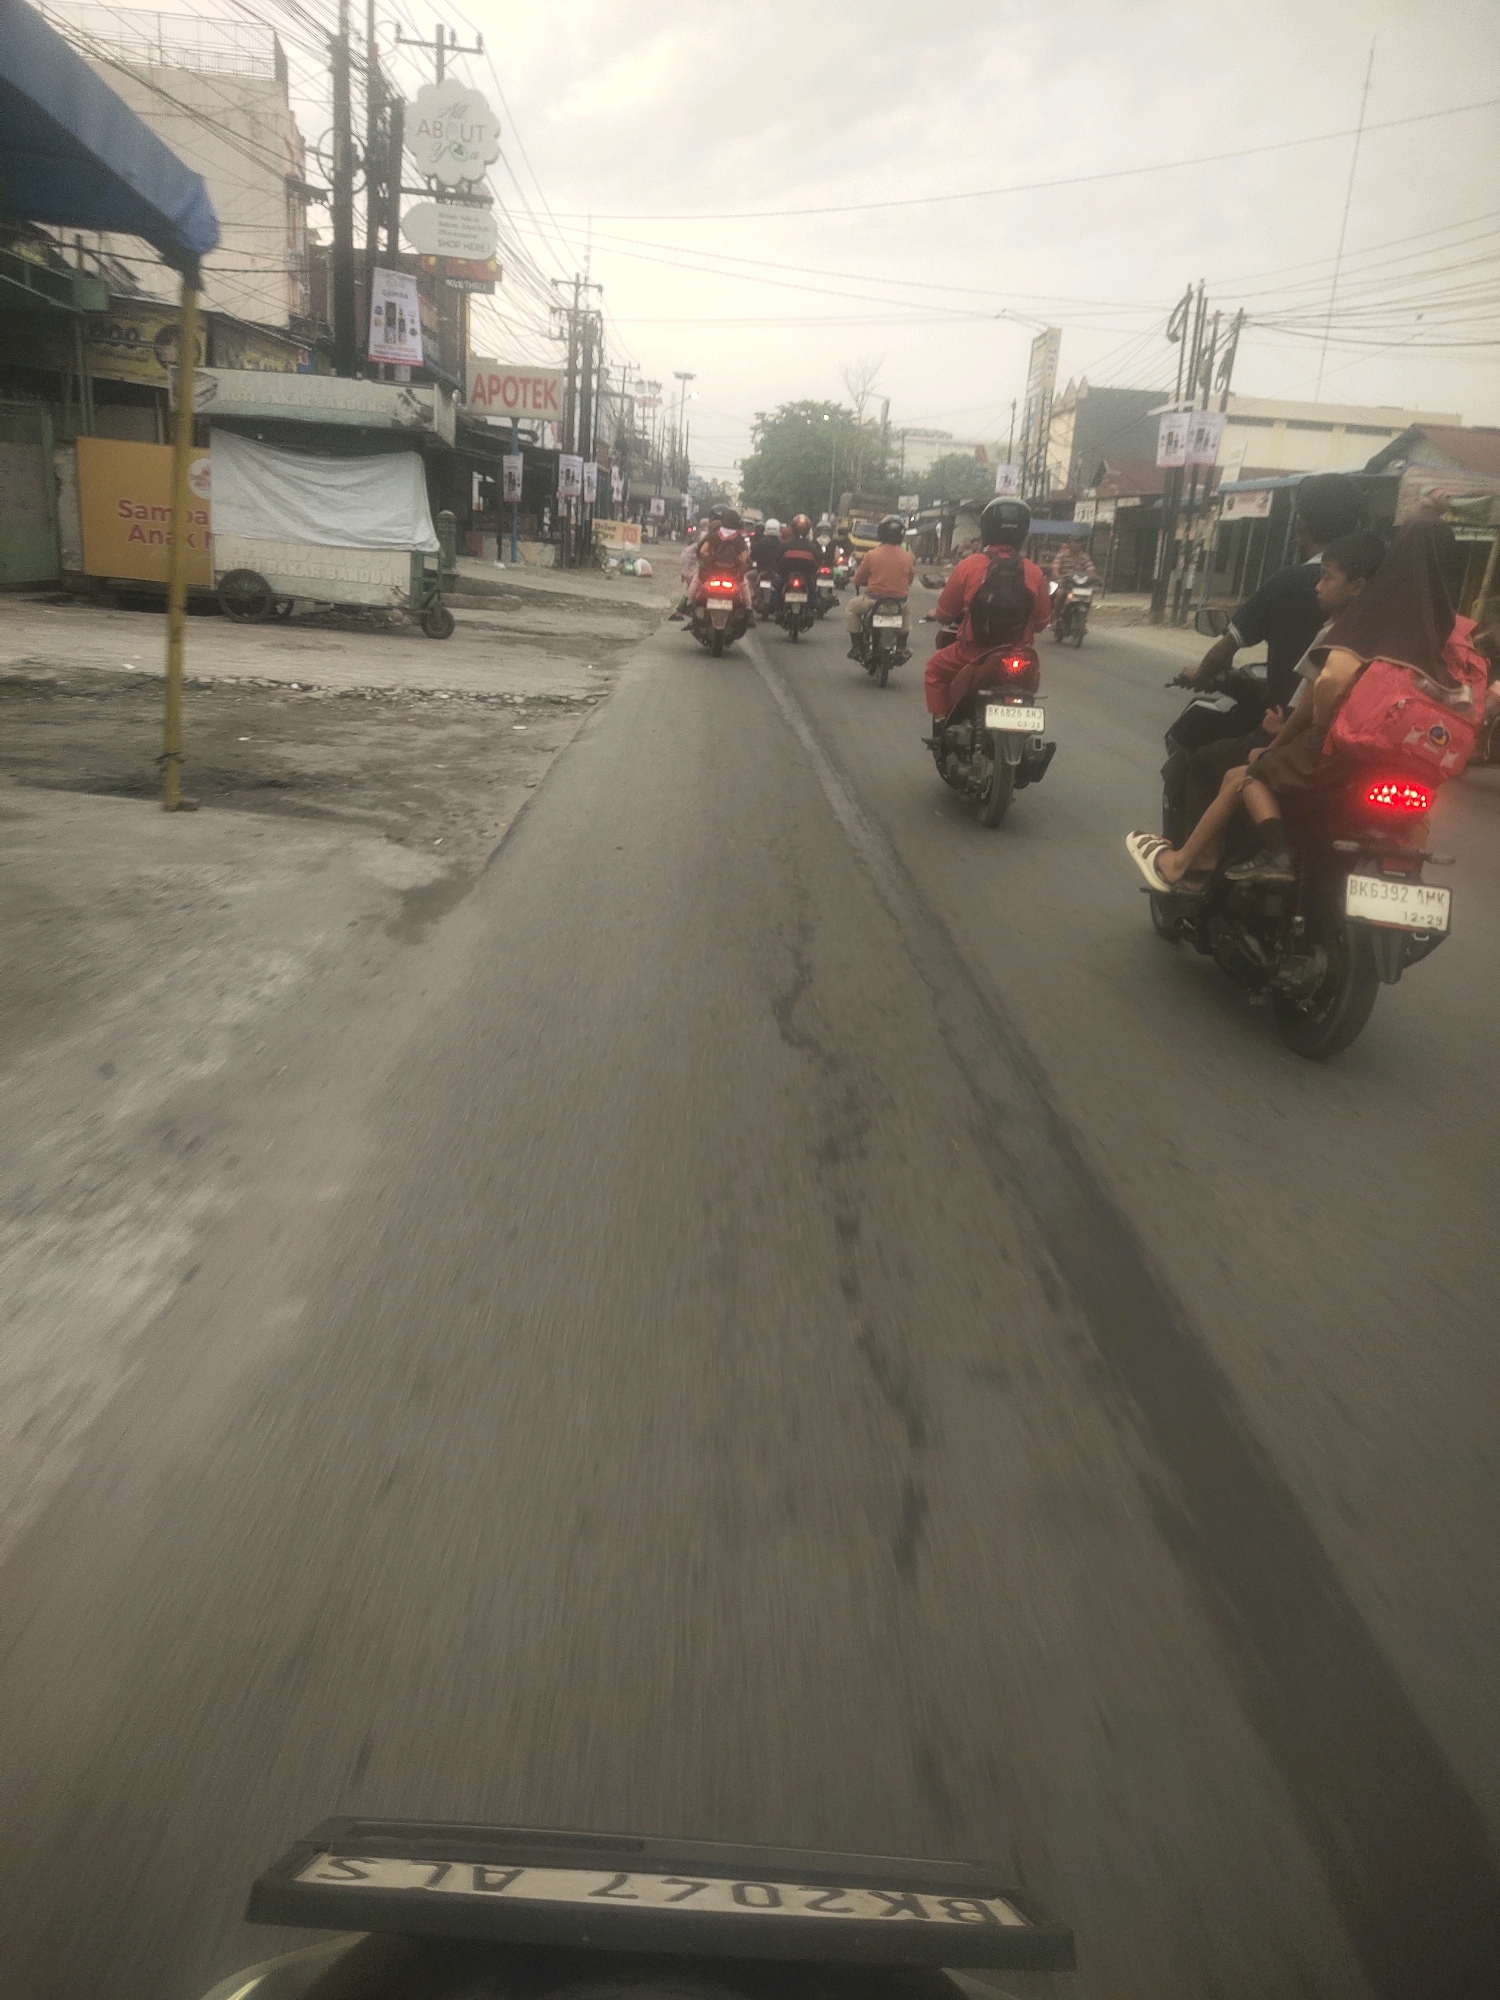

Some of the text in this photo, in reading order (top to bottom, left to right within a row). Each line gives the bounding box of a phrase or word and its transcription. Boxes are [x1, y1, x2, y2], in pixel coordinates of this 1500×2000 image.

[416, 119, 487, 143] ABOUT
[471, 373, 559, 411] APOTEK
[1349, 879, 1409, 902] BK6392
